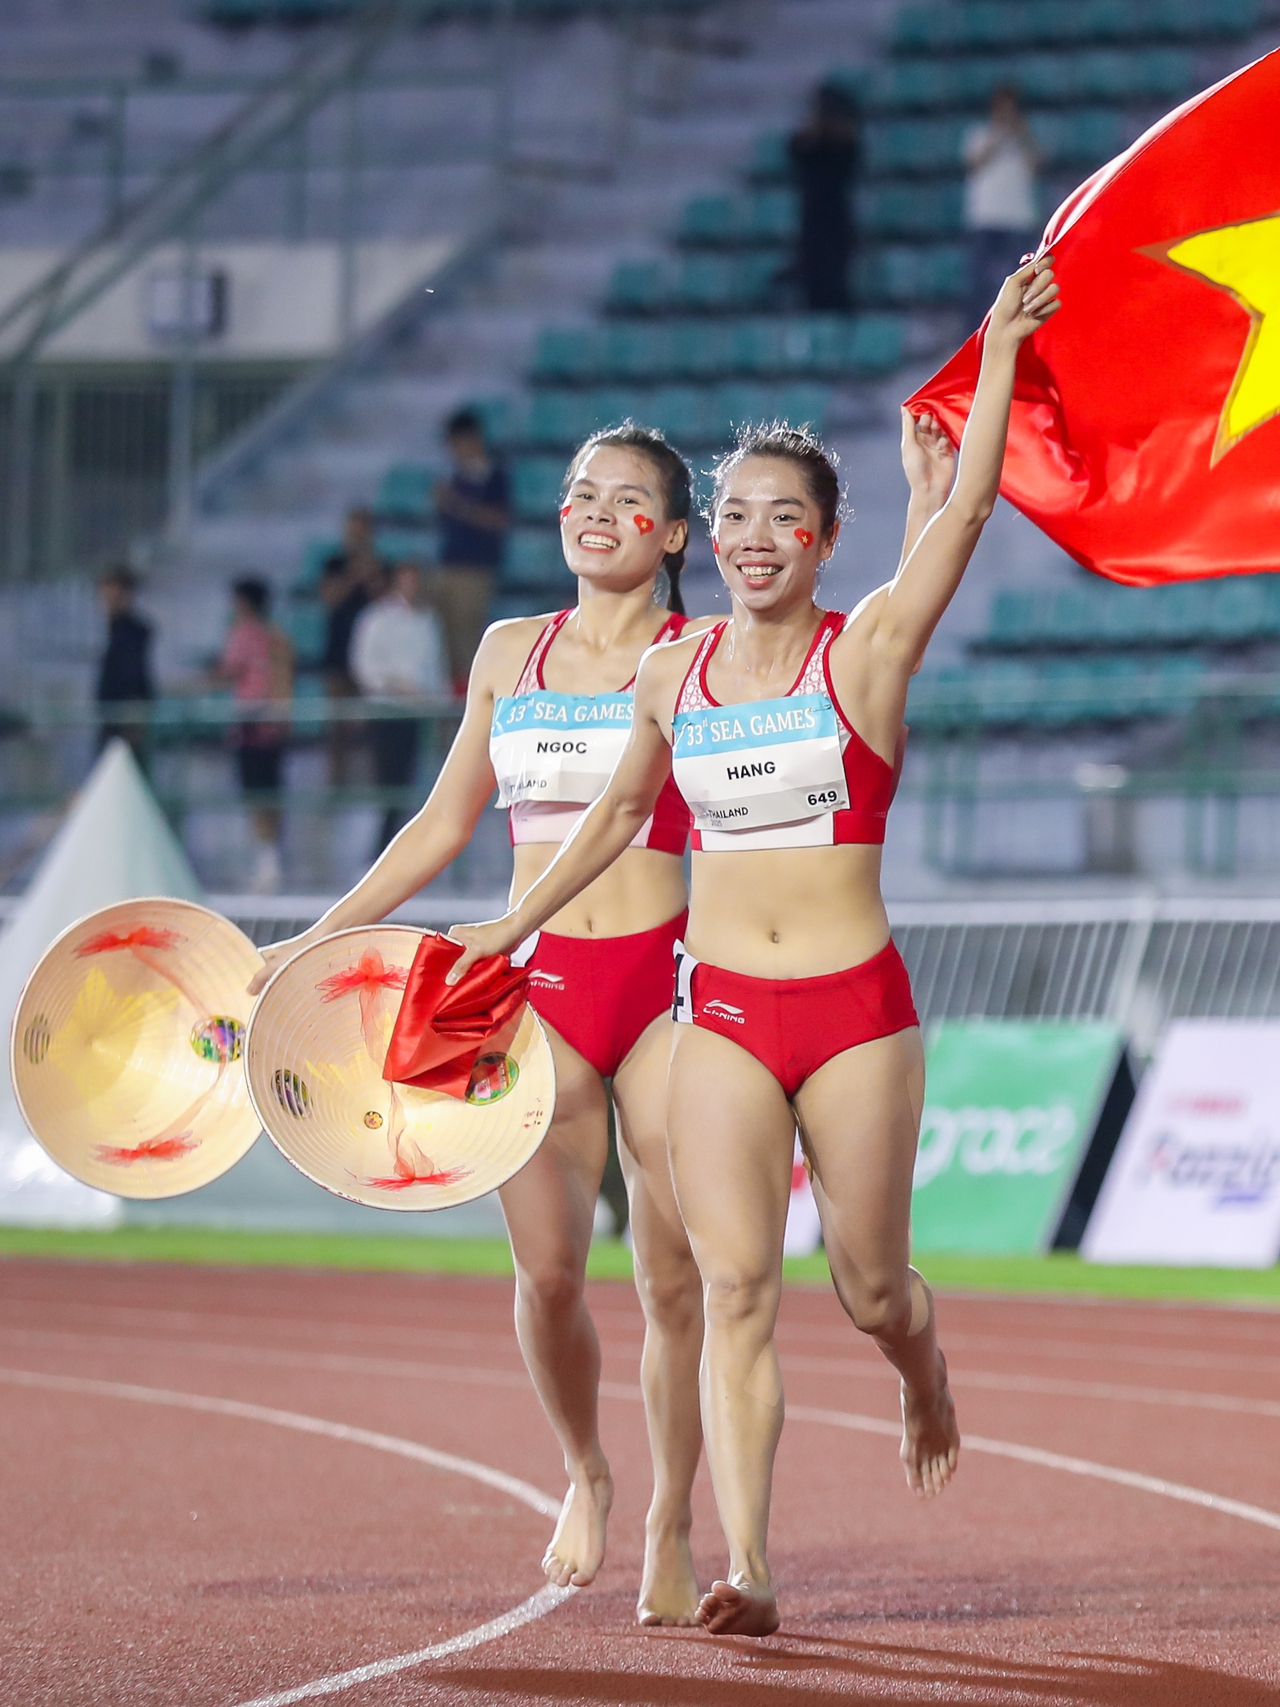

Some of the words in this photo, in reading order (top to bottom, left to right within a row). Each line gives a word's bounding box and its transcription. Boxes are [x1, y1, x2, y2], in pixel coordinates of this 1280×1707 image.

[534, 701, 568, 722] SEA
[574, 703, 635, 722] GAMES
[710, 718, 746, 742] SEA
[749, 709, 816, 736] GAMES
[536, 741, 588, 754] NGOC
[726, 761, 776, 780] HANG
[807, 790, 838, 806] 649
[707, 806, 749, 819] THAILAND
